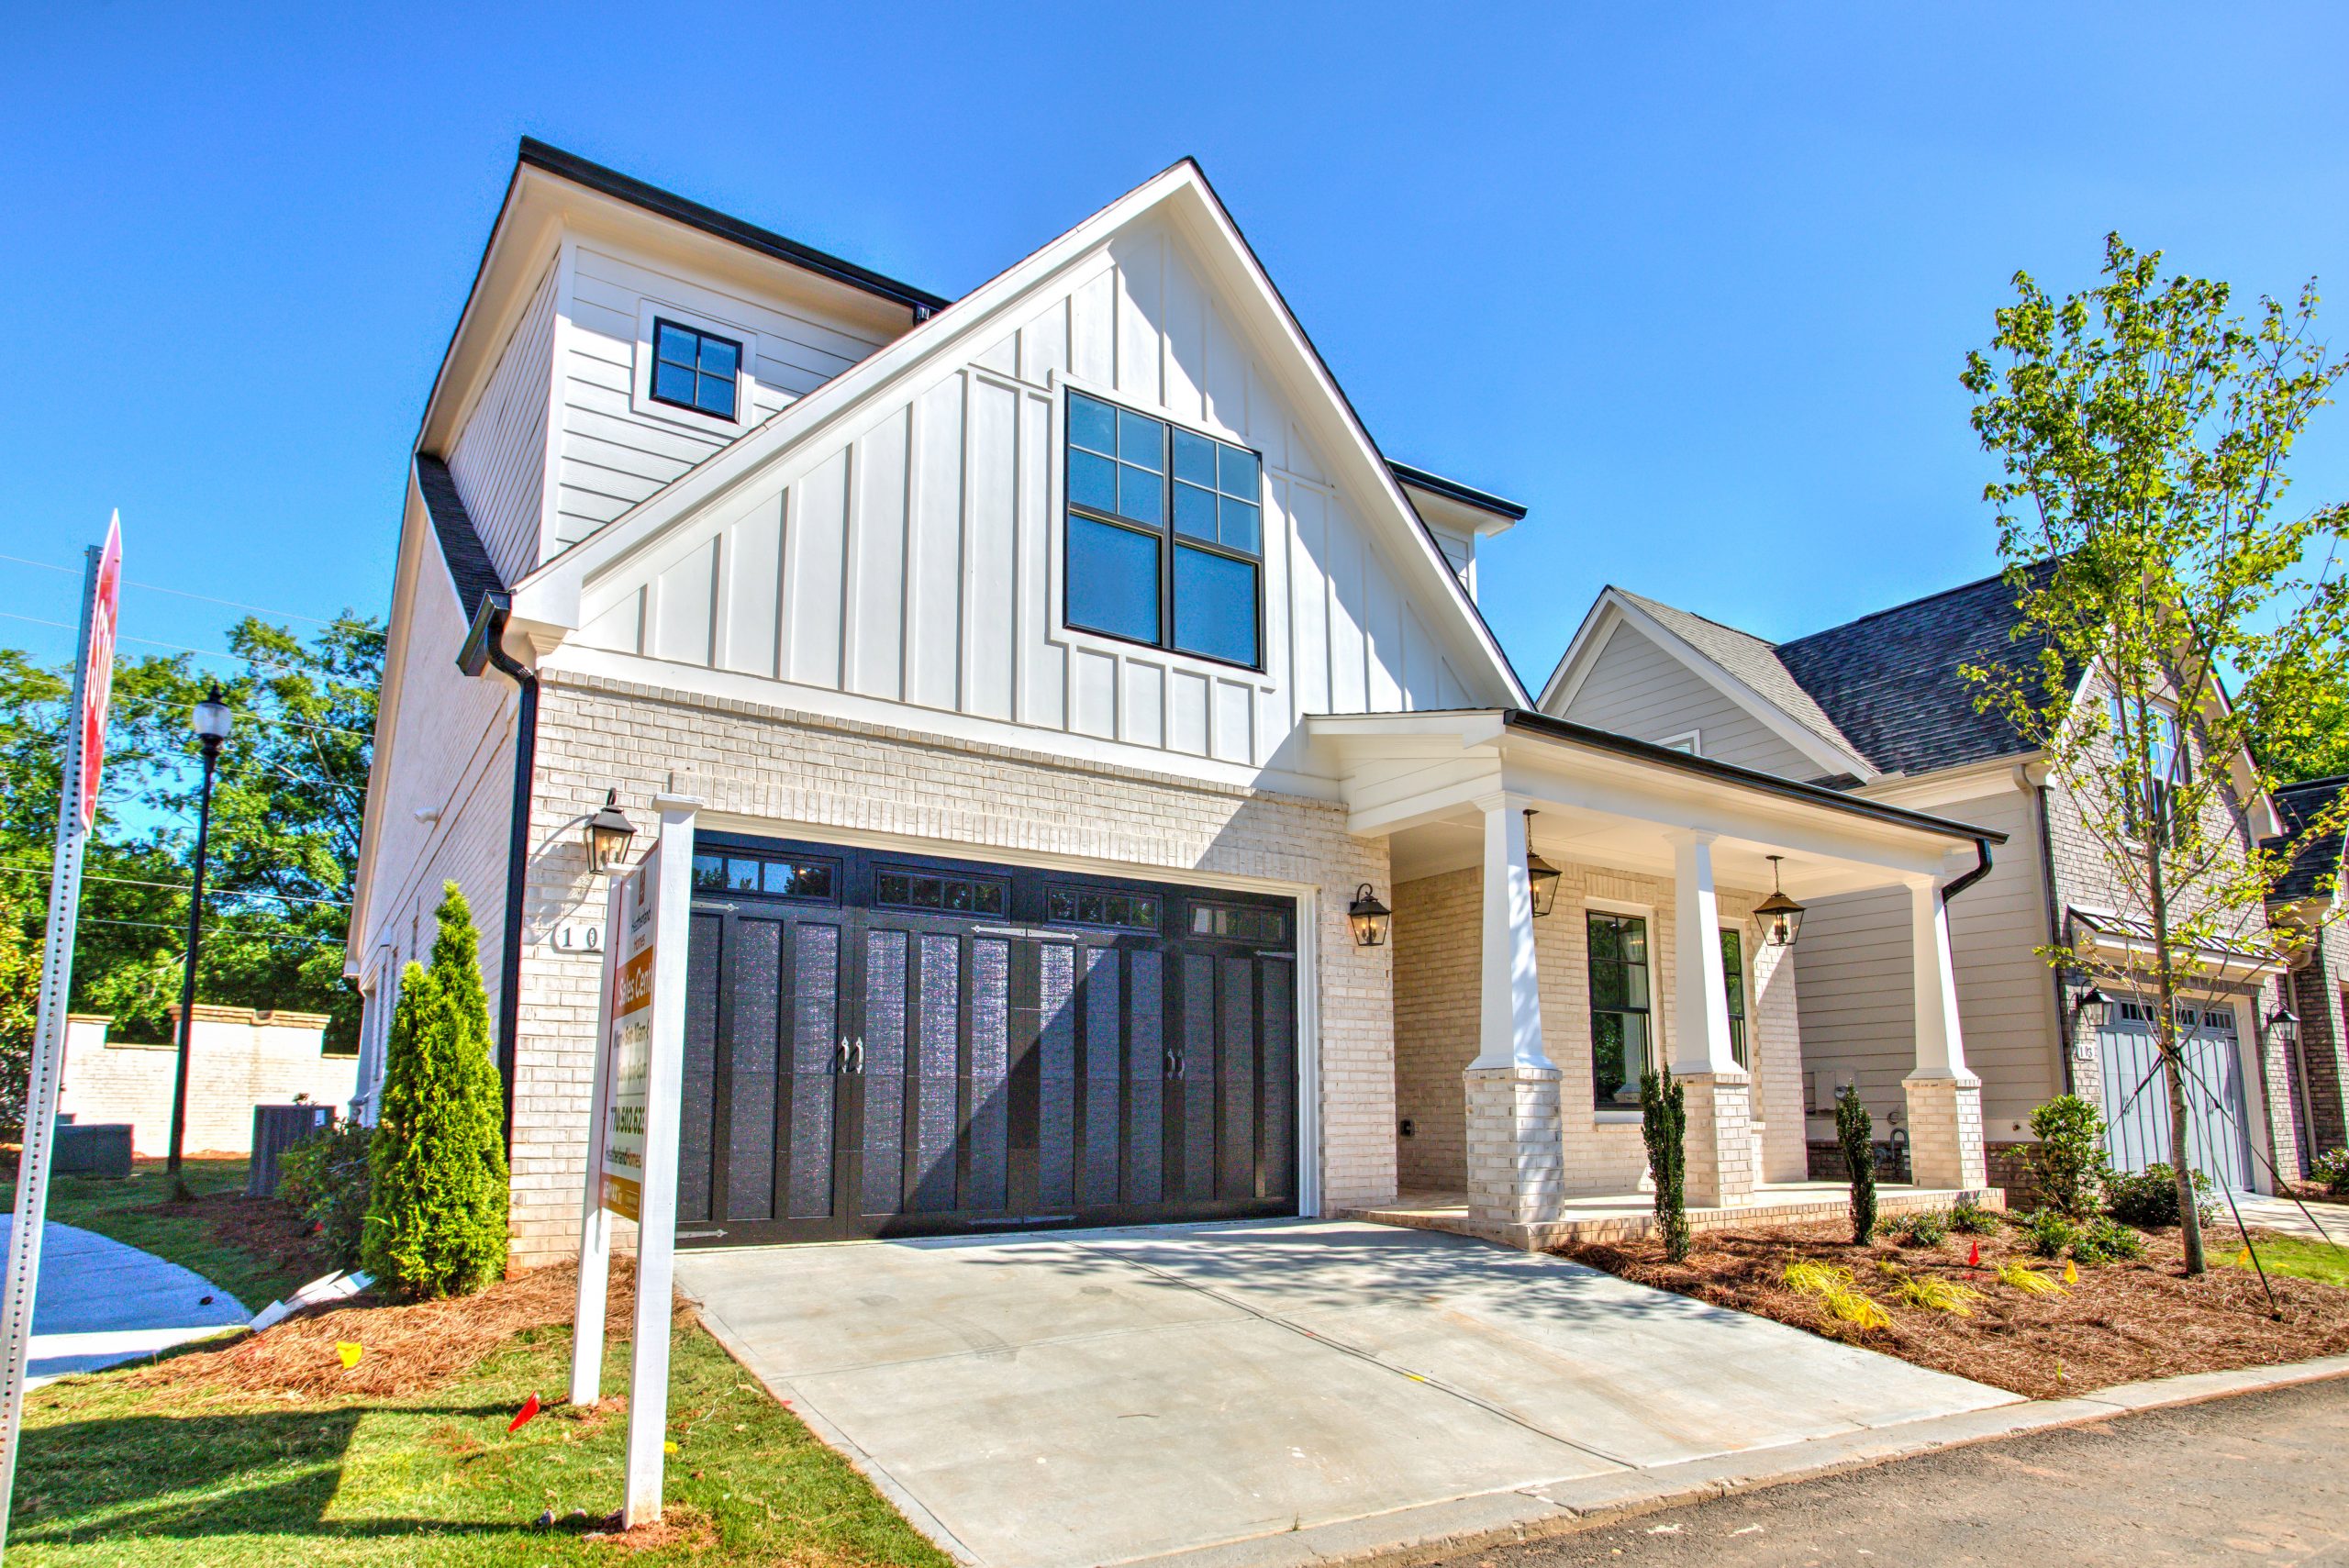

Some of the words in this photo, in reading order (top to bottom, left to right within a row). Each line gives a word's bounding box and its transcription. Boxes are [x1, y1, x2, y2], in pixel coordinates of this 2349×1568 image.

[618, 973, 634, 1007] Sales
[635, 962, 651, 998] Cent
[609, 1106, 645, 1136] 770.502.623
